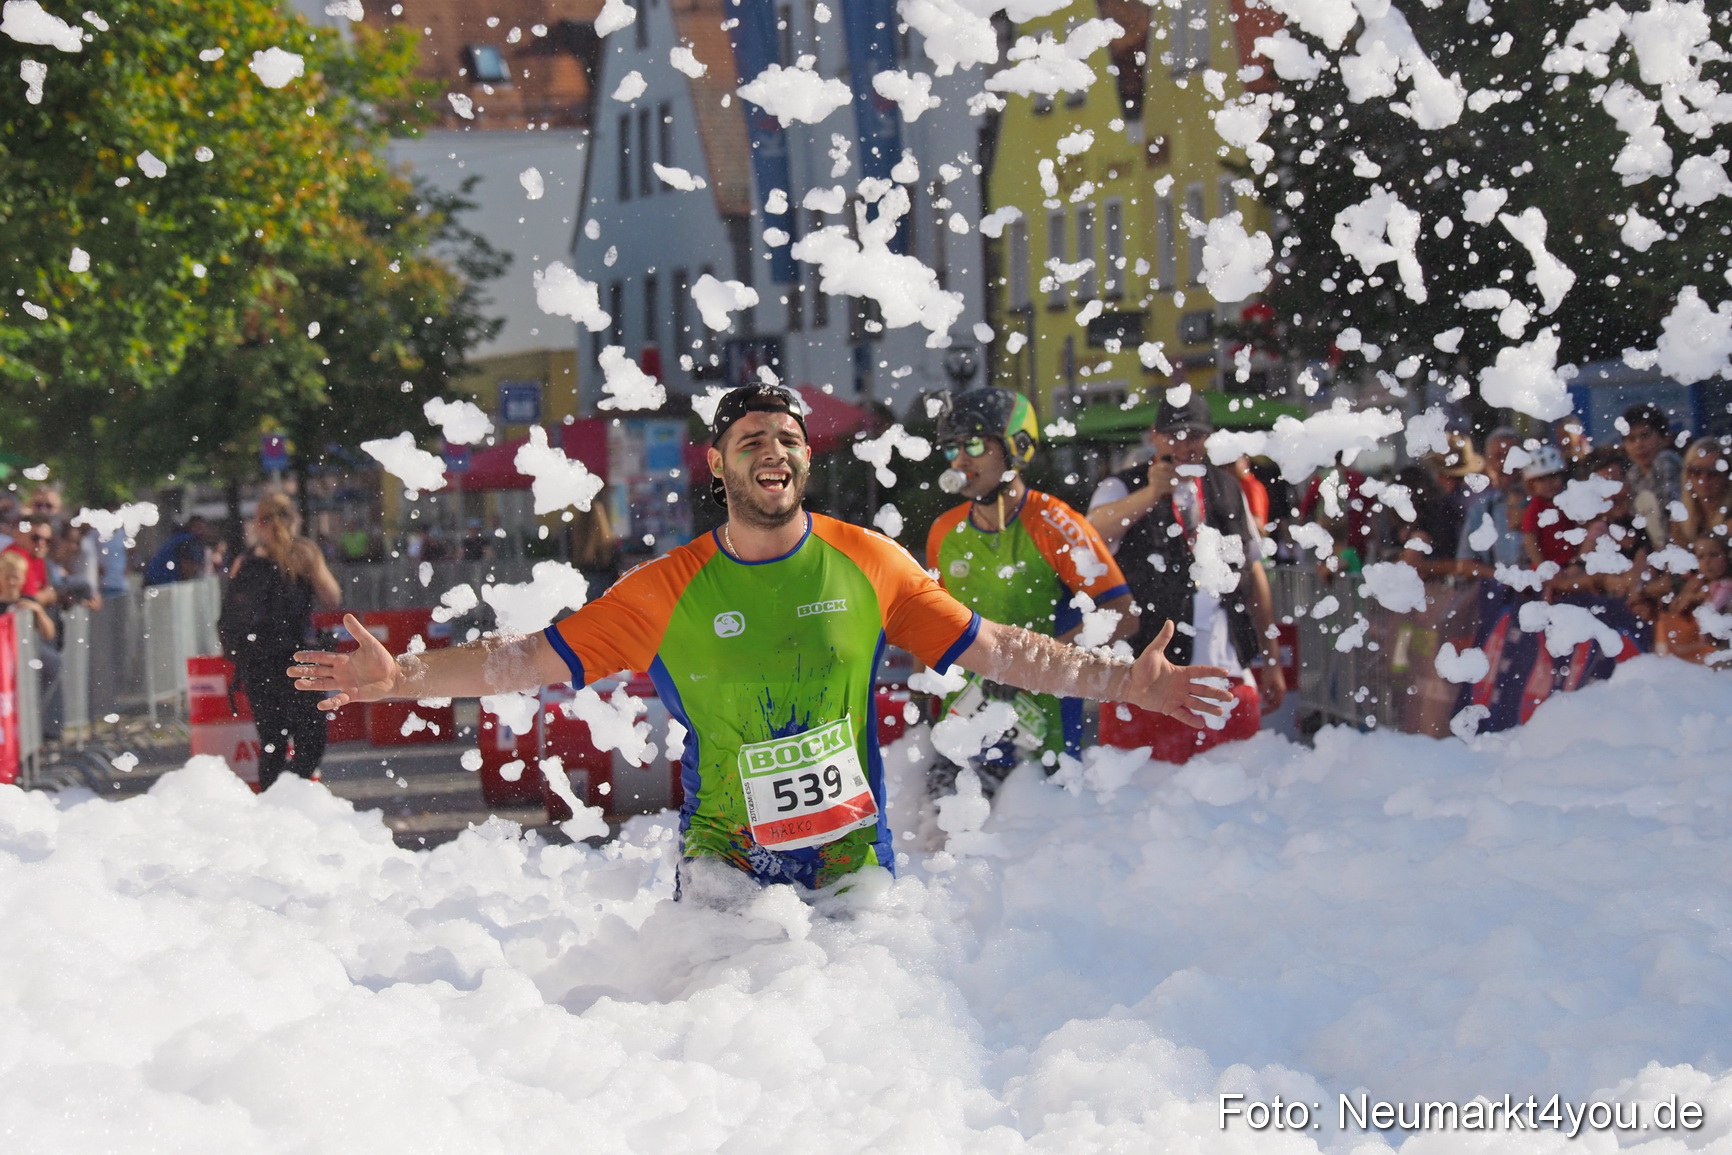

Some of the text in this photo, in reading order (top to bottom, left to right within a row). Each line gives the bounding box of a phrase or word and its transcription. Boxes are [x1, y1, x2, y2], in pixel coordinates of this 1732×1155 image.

[797, 599, 847, 617] BOCK
[746, 724, 846, 773] BOCK
[772, 764, 842, 812] 539
